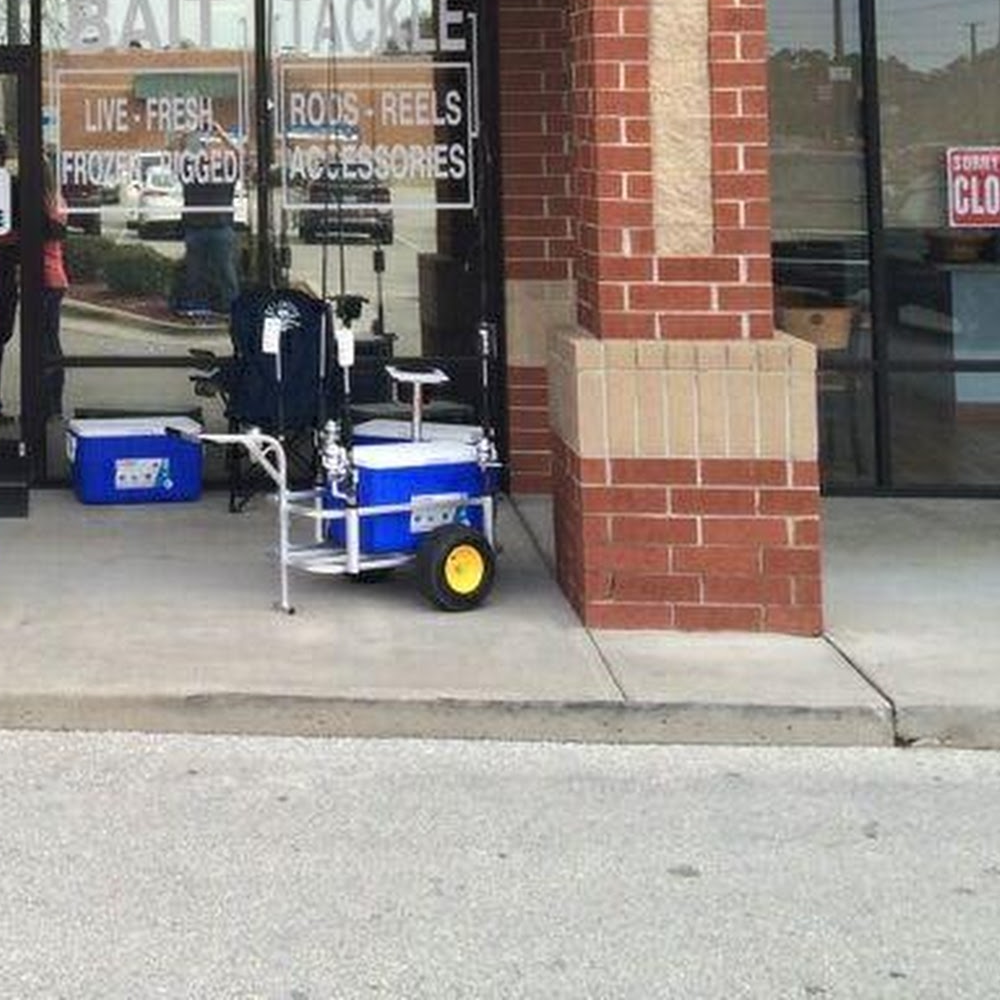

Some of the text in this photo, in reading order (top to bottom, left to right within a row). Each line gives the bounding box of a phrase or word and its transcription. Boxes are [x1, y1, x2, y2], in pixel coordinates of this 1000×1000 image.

[85, 98, 129, 132] LIVE
[145, 96, 214, 133] FRESH
[289, 90, 359, 126] RODS
[381, 90, 462, 126] REELS
[289, 142, 466, 180] ACCESSORIES
[954, 175, 1000, 214] CLO
